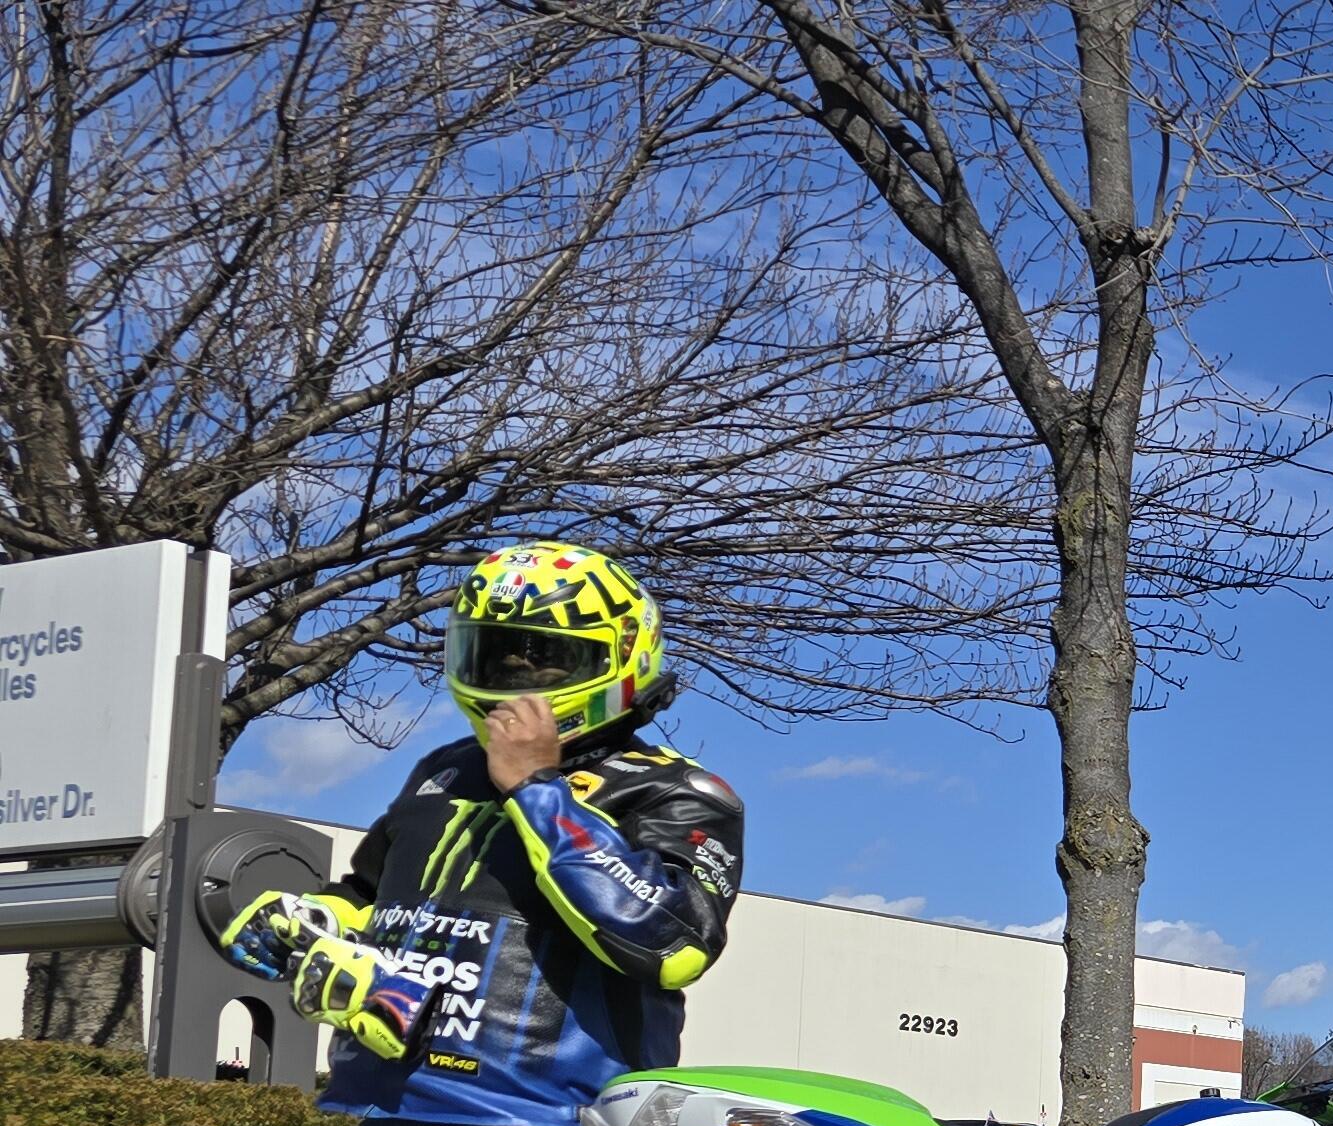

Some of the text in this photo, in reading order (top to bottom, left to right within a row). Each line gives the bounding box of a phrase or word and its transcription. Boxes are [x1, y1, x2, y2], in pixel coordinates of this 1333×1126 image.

[61, 783, 95, 819] Dr.
[371, 905, 491, 944] MONSTER
[899, 1013, 958, 1037] 22923
